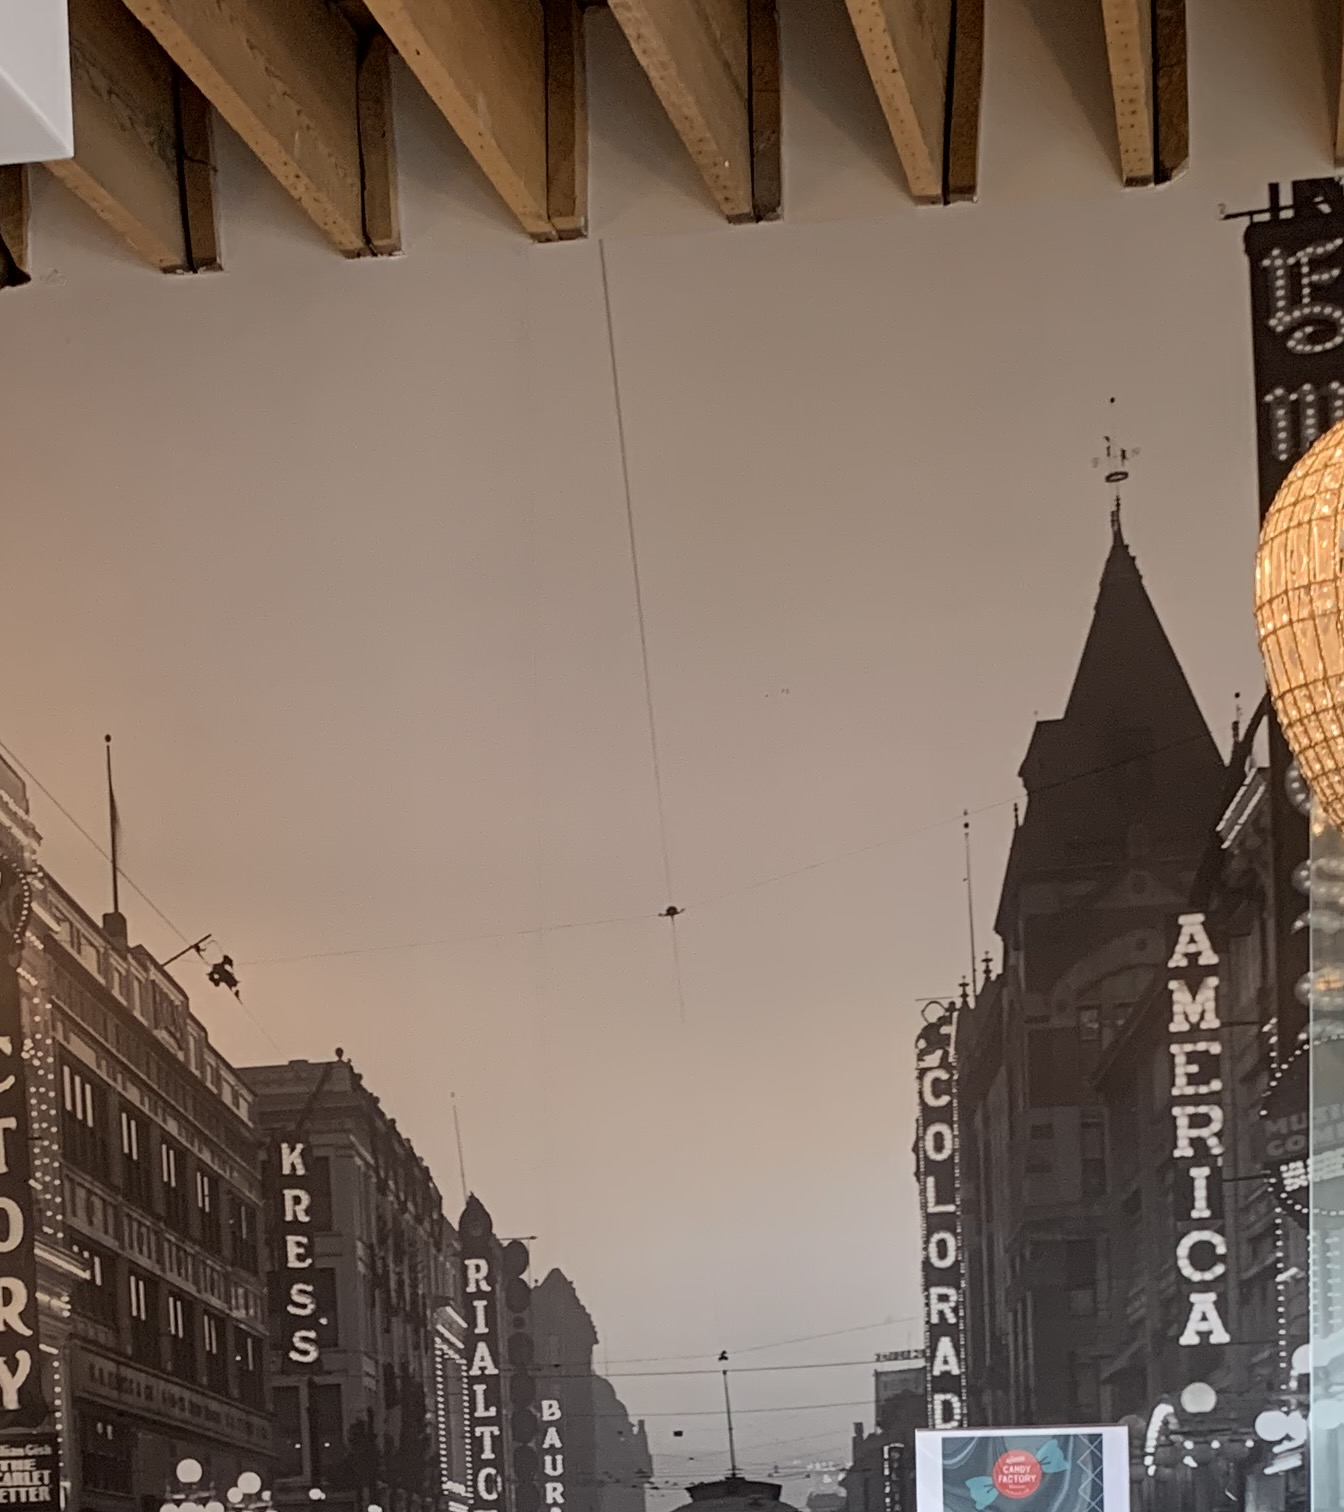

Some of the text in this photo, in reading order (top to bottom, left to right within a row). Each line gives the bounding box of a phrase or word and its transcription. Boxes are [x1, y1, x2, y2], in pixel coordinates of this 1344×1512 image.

[1167, 913, 1231, 1346] AMERICA
[465, 1258, 502, 1501] RIALTO
[997, 1473, 1037, 1484] FACTORY
[1002, 1464, 1032, 1475] CANDY
